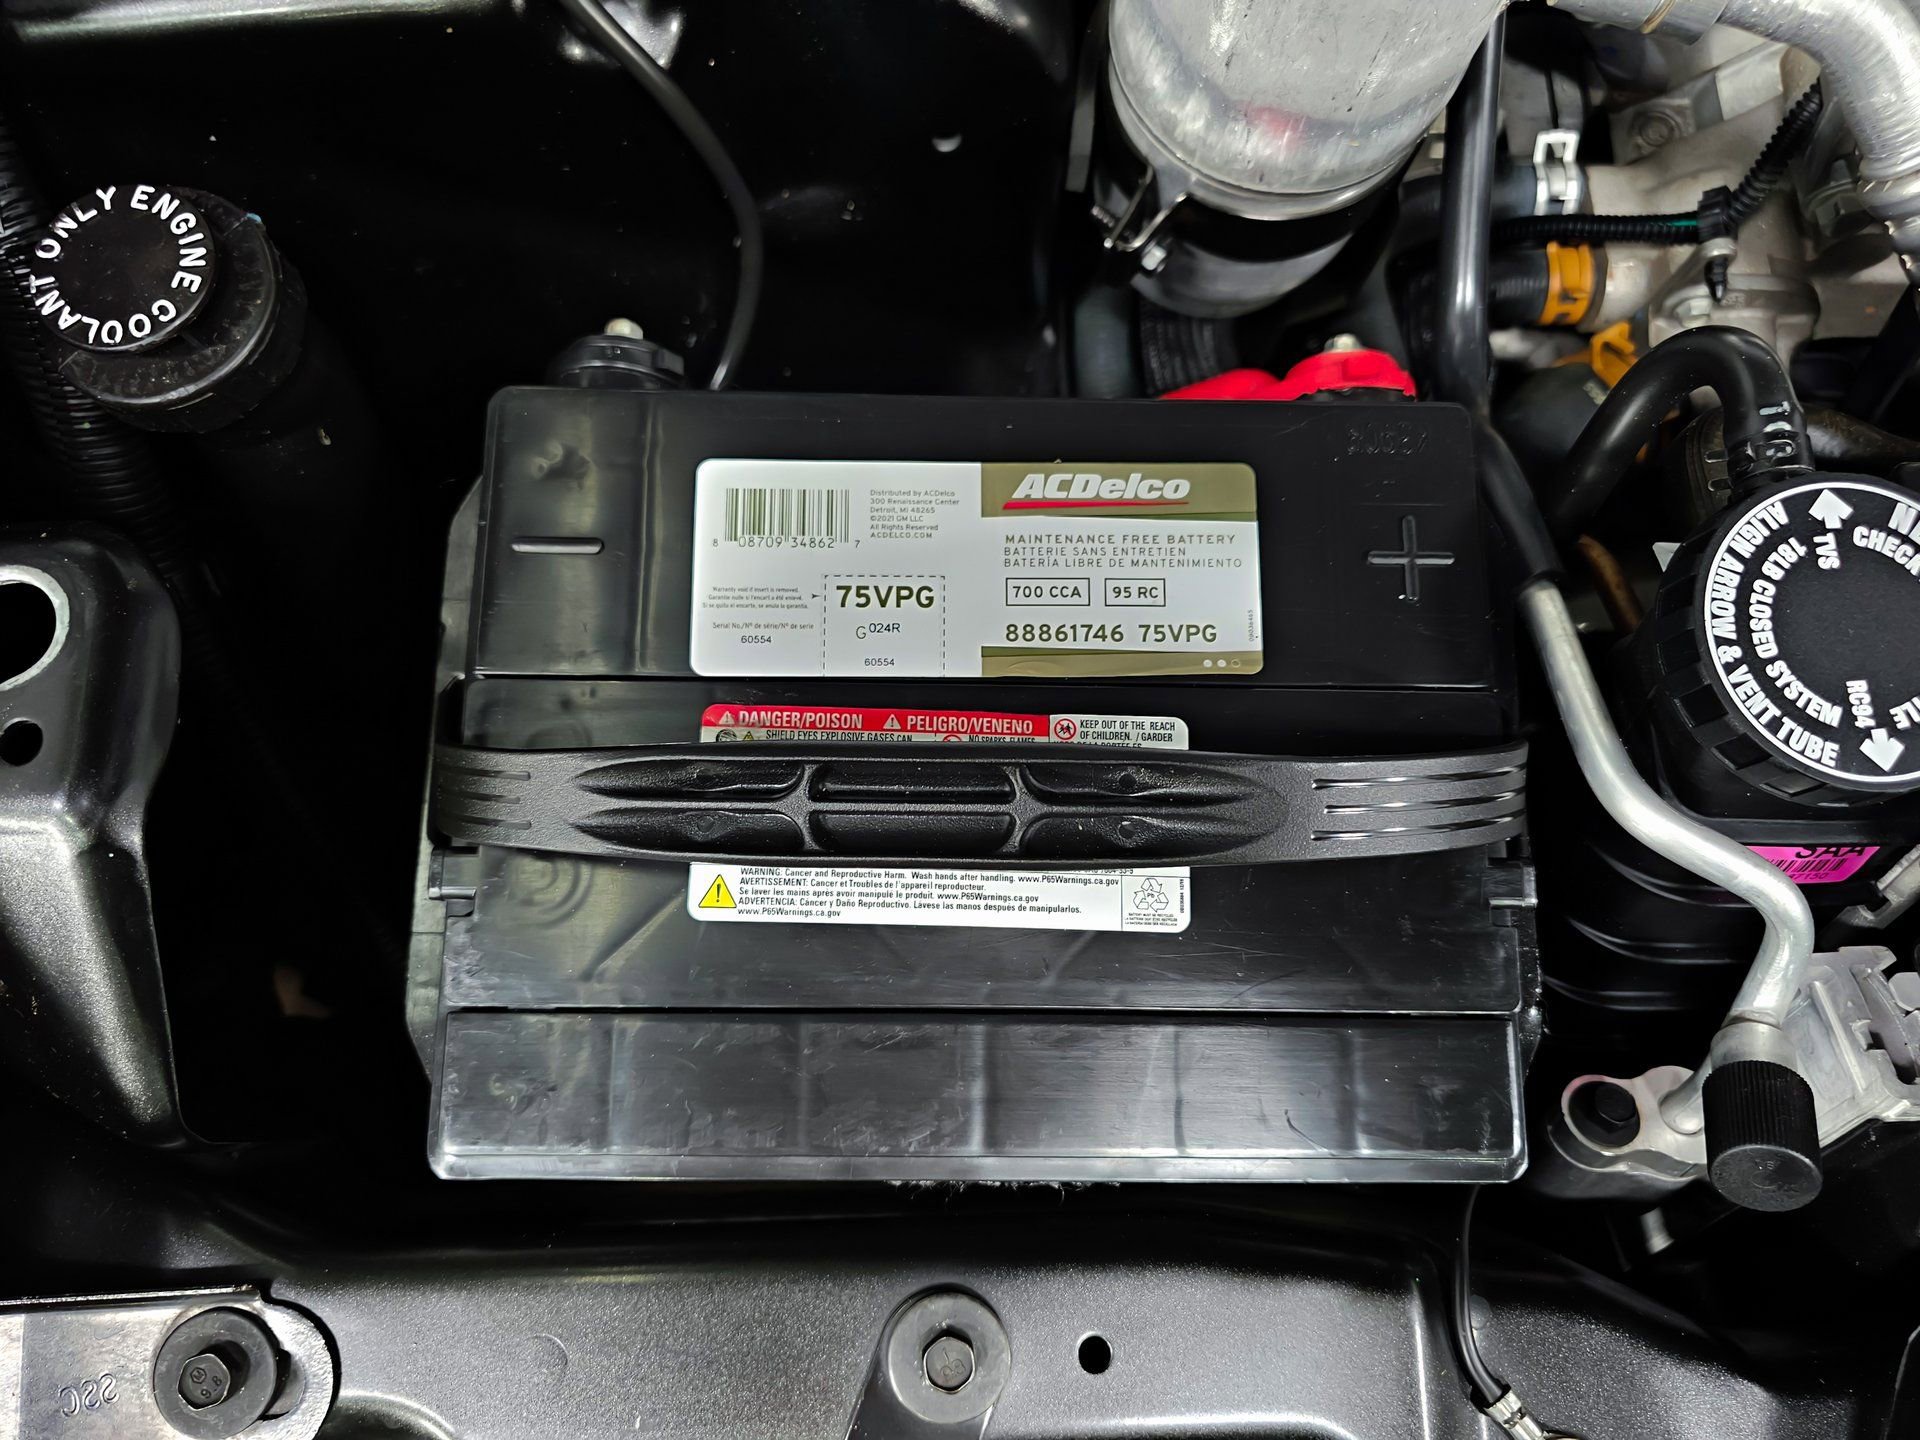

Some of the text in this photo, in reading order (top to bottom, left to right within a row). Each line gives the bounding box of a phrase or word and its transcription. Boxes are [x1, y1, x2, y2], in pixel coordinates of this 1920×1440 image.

[29, 184, 207, 344] ENGINE COOLANT ONLY
[1011, 473, 1191, 500] ACDelco
[913, 490, 922, 498] by
[882, 524, 903, 532] Rights
[1728, 500, 1790, 560] ALIGN
[712, 536, 860, 548] 8 08709 34862 7
[1005, 534, 1236, 544] MAINTENANCE FREE BATTERY
[1004, 547, 1186, 556] BATTERIE SANS ENTRETIEN
[1812, 532, 1842, 570] TVS
[1004, 556, 1242, 568] BATERÍA LIBRE DE MANTENIMIENTO
[836, 585, 935, 609] 75VPG
[1012, 586, 1082, 598] 700 CCA
[1112, 586, 1159, 599] 95 RC
[1710, 552, 1745, 640] ARROW
[712, 622, 730, 630] Serial
[754, 622, 761, 630] de
[790, 622, 797, 630] de
[800, 622, 814, 630] serie
[856, 626, 866, 640] G
[869, 622, 900, 634] 024R
[1749, 536, 1844, 728] 18LB CLOSED SYSTEM
[740, 635, 772, 644] 60554
[1006, 624, 1217, 643] 88861746 75VPG
[1716, 644, 1742, 664] &
[864, 658, 895, 667] 60554
[1727, 663, 1782, 726] VENT
[1846, 680, 1876, 729] RC94
[738, 711, 1033, 734] DANGER/POISON PELIGRO/VENENO
[1080, 719, 1176, 731] KEEP OUT OF THE REACH
[766, 730, 796, 740] SHIELD
[798, 730, 818, 741] EYES
[1080, 730, 1090, 740] OF
[1140, 732, 1173, 742] GARDER
[1775, 716, 1841, 768] TUBE
[740, 868, 1119, 887] WARNING: Cancer and Reproductive Harm. Wash hands after handling. www.P65Warnings.ca.gov
[740, 878, 986, 892] AVERTISSEMENT: Cancer et Troubles de l'appareil reproducteur.
[751, 888, 771, 896] laver
[773, 888, 785, 896] les
[787, 888, 810, 897] mains
[812, 889, 834, 898] après
[836, 890, 856, 898] avoir
[858, 889, 893, 900] manipulé
[896, 891, 903, 899] le
[905, 891, 935, 901] produit.
[938, 892, 1039, 904] www.P65Warnings.ca.gov
[738, 897, 797, 906] ADVERTENCIA:
[799, 898, 826, 907] Cáncer
[829, 900, 833, 909] y
[836, 898, 856, 908] Daño
[858, 899, 912, 909] Reproductivo.
[913, 900, 940, 909] Lávese
[984, 902, 1015, 913] después
[1018, 904, 1027, 912] de
[1029, 904, 1082, 914] manipularlos.
[738, 907, 841, 918] www.P65Warnings.ca.gov
